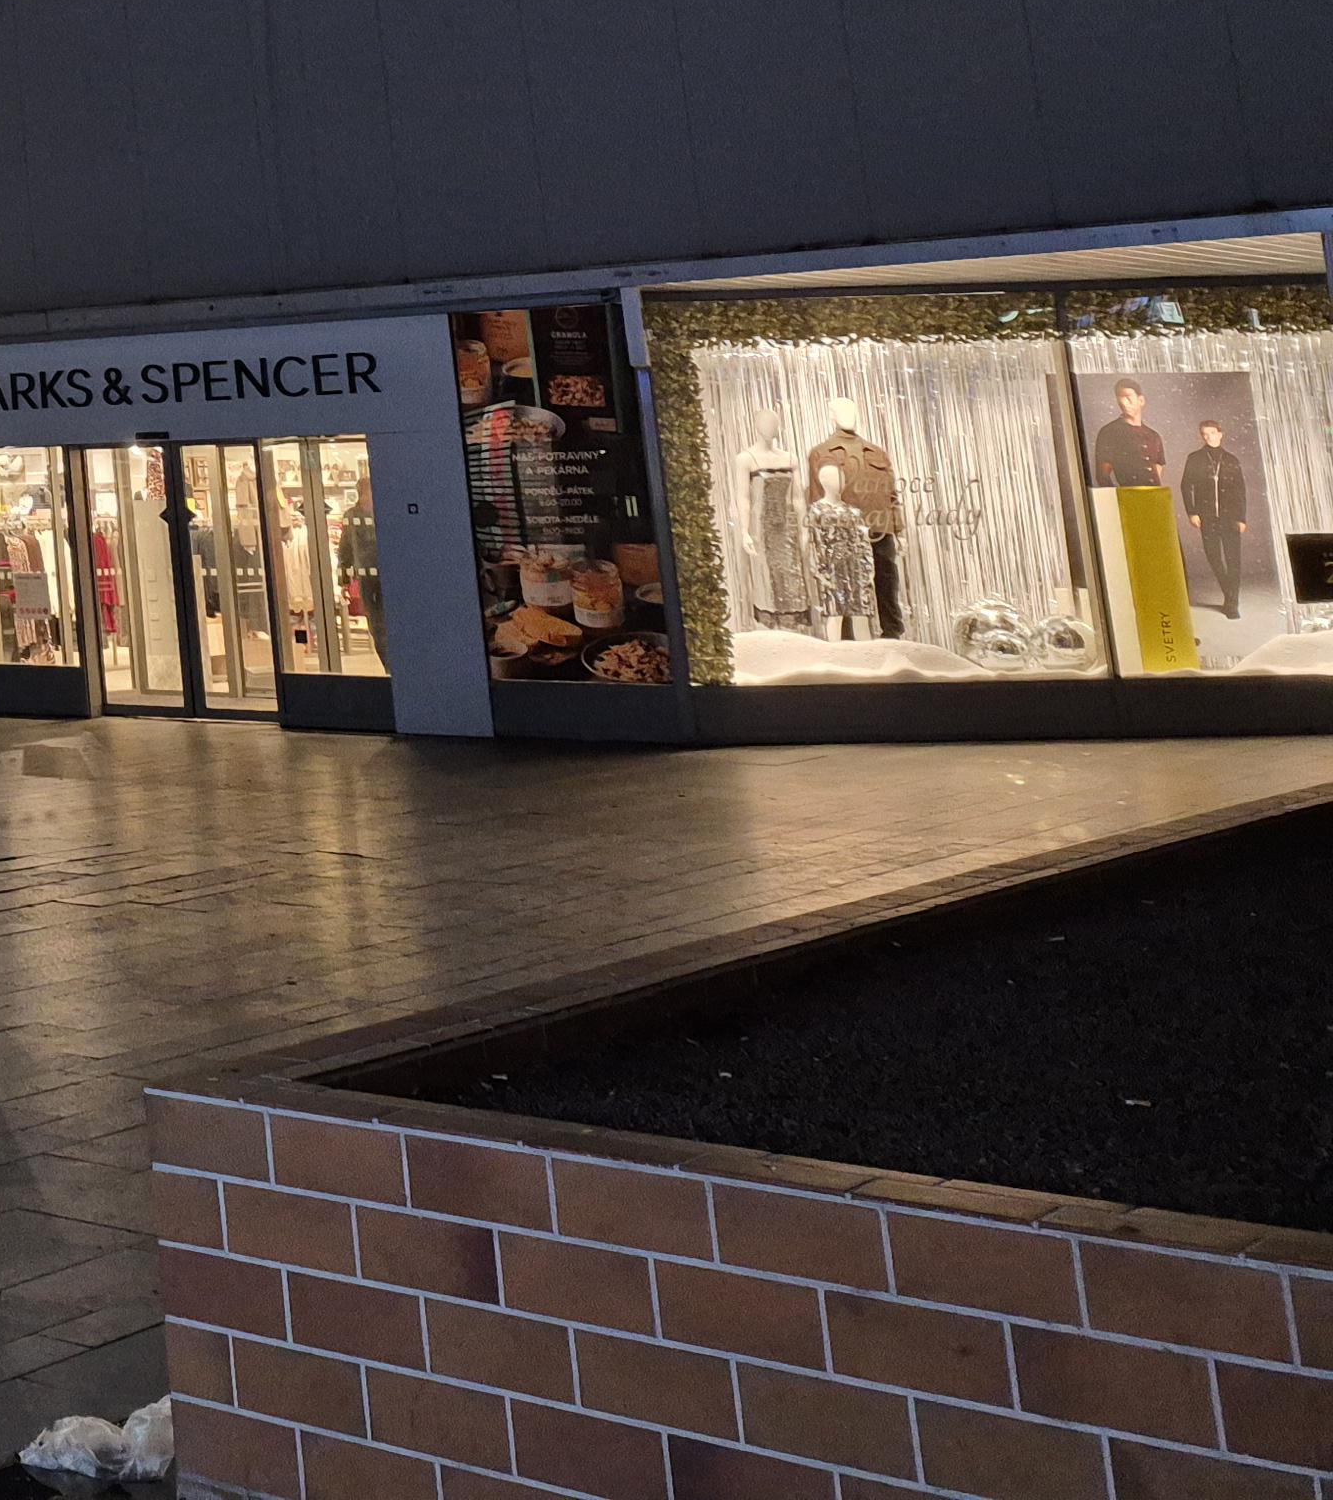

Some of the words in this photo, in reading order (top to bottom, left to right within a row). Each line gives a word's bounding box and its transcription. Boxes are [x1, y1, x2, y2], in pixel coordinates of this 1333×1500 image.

[102, 367, 134, 406] &
[140, 352, 383, 404] SPENCER
[537, 465, 589, 475] PEKÁRNA
[538, 450, 599, 461] POTRAVINY
[1158, 611, 1178, 663] SVETRY
